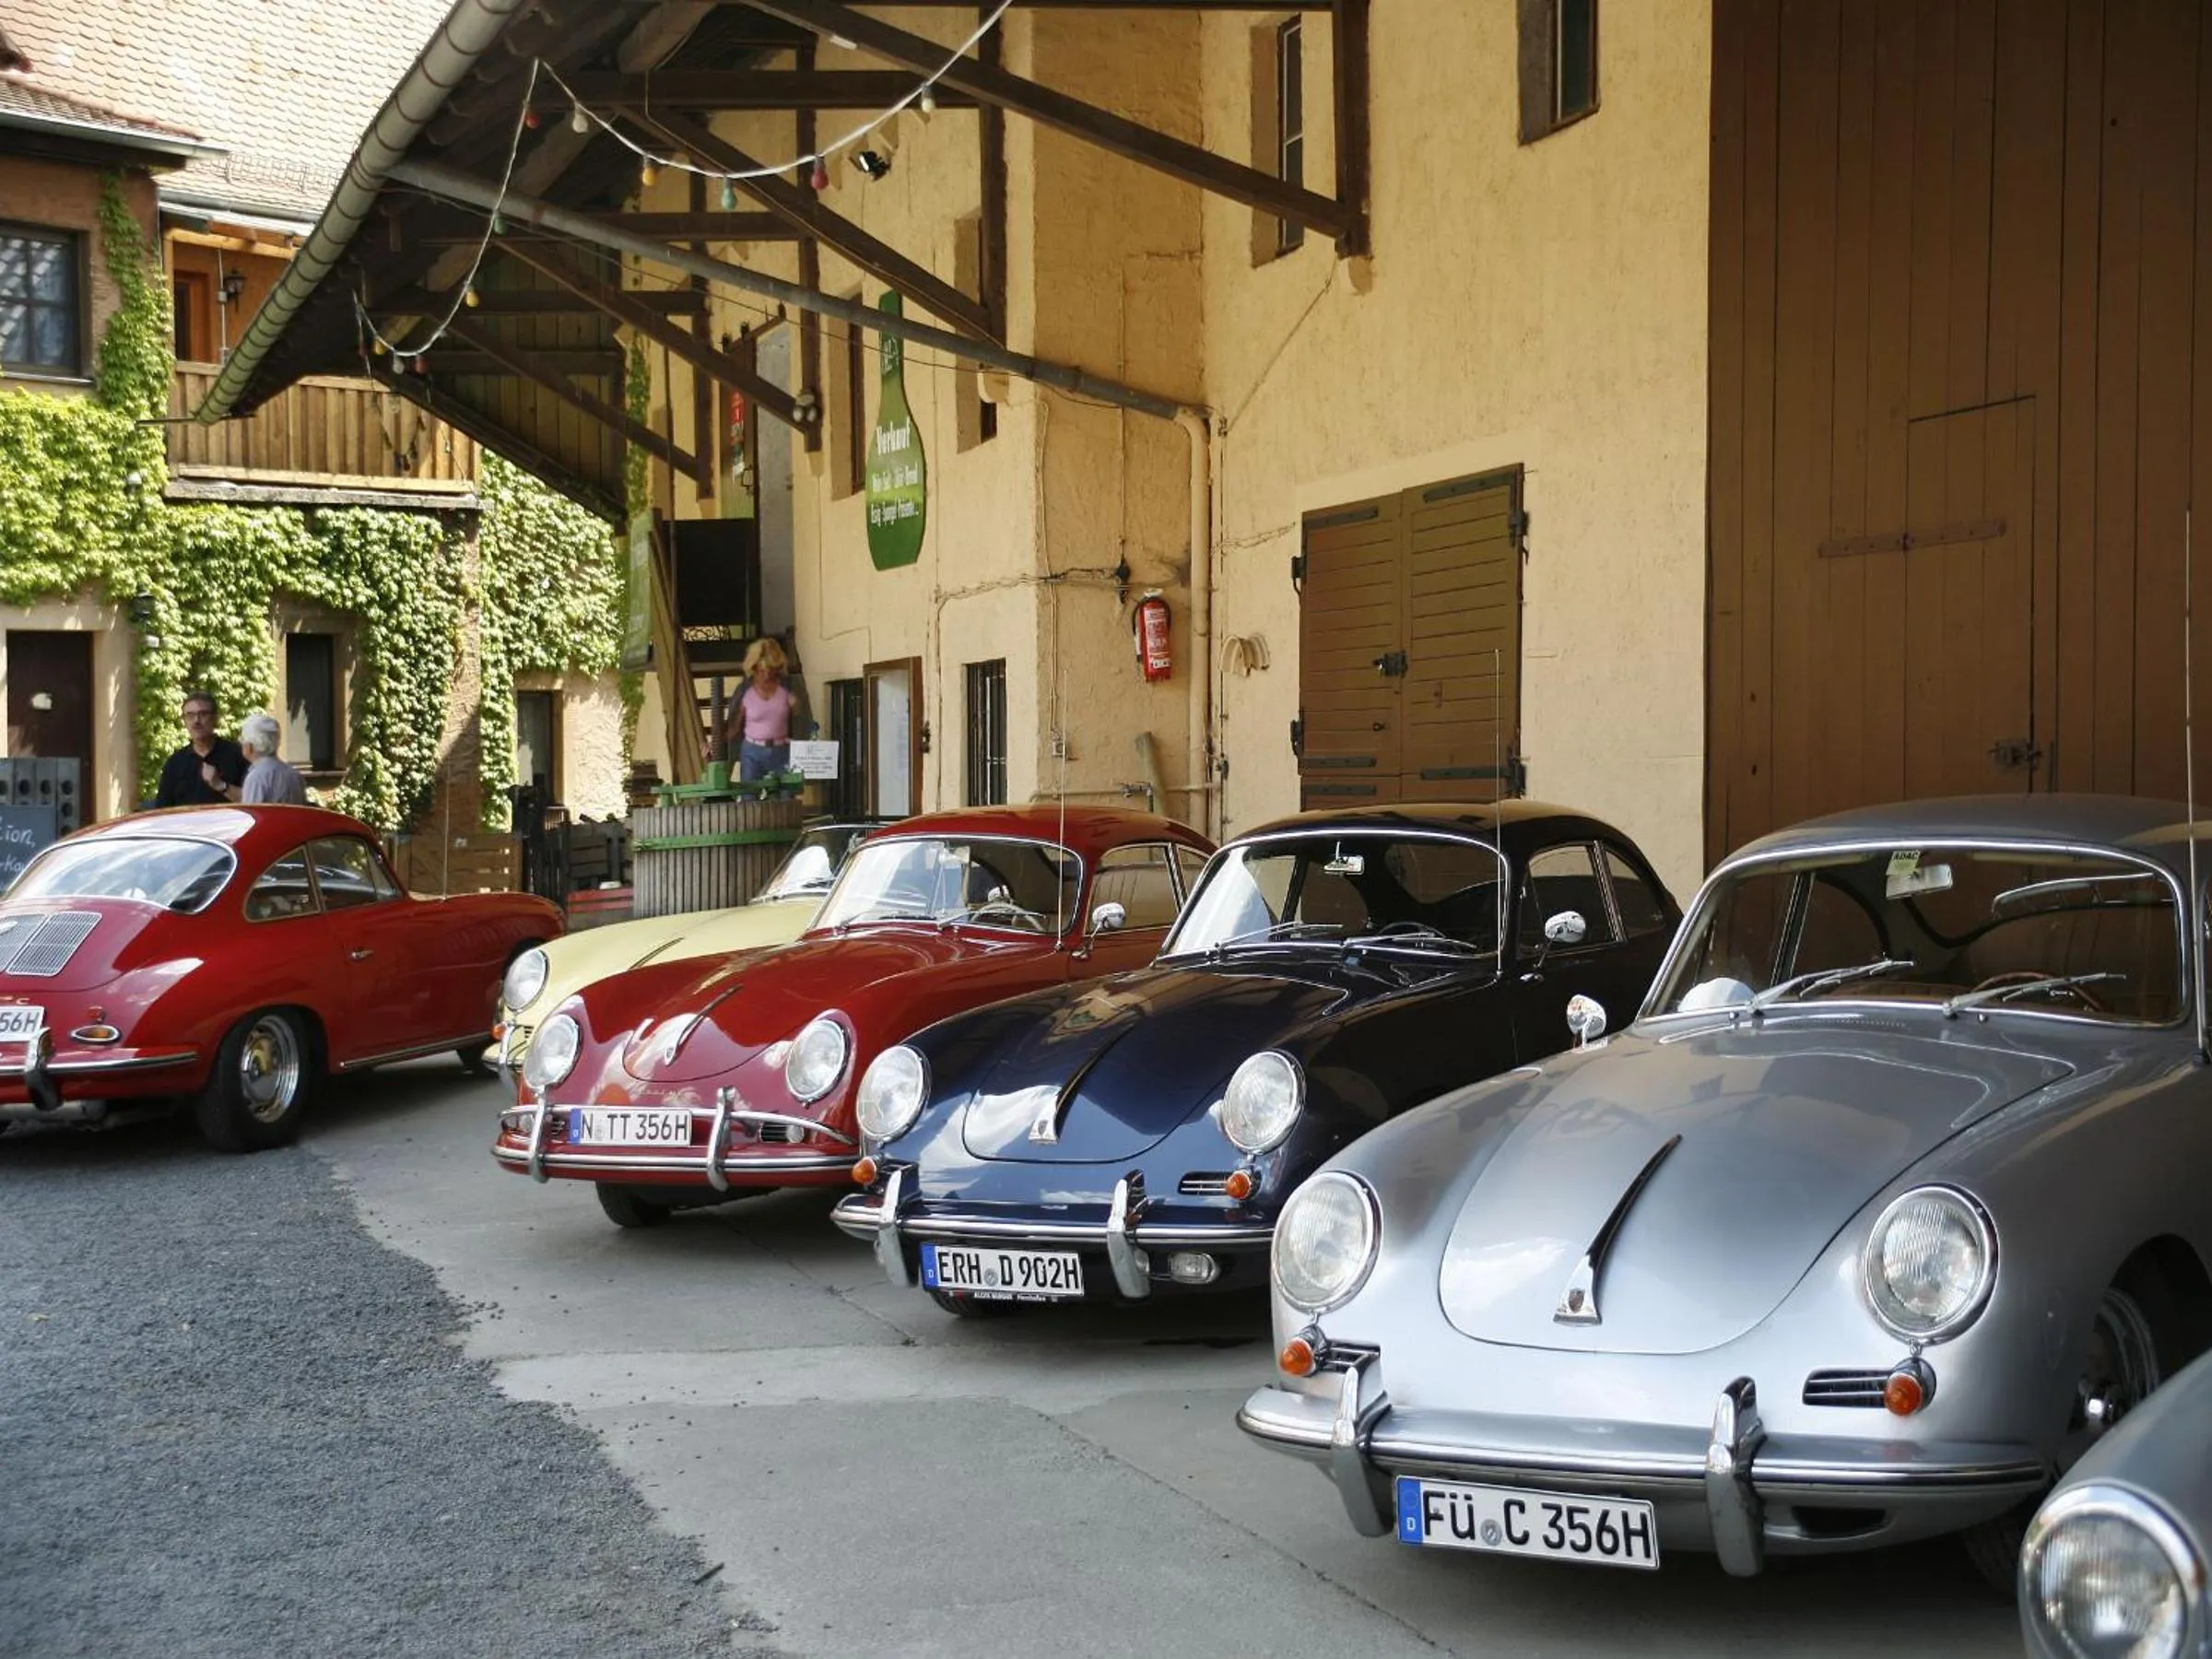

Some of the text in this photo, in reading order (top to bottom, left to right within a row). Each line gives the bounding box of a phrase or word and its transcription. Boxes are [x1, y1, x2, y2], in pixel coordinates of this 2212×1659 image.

[877, 416, 911, 455] Verkauf
[1892, 851, 1919, 860] ADAC
[582, 1113, 594, 1139] N
[606, 1114, 631, 1139] TT
[635, 1114, 688, 1141] 356H
[937, 1252, 982, 1284] ERH
[998, 1254, 1013, 1286] D
[1018, 1256, 1079, 1289] 902H
[1406, 1490, 1652, 1559] D FÜ C 356H
